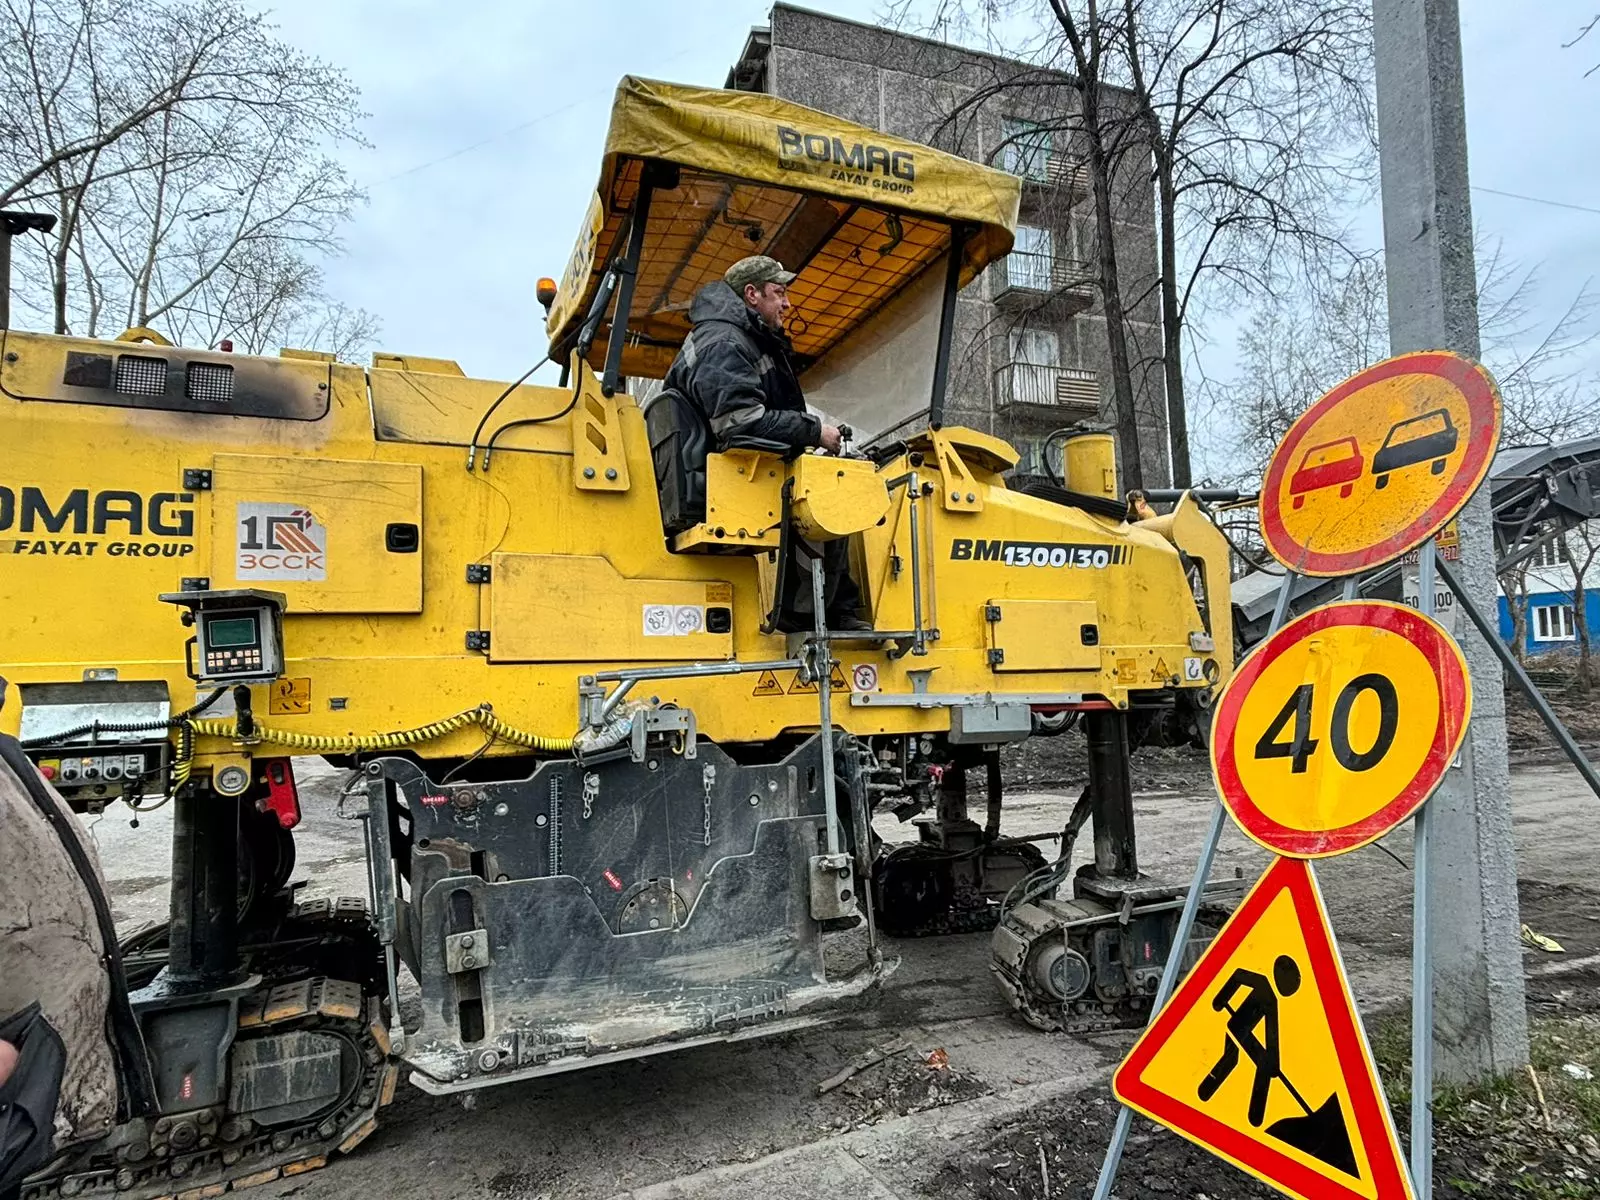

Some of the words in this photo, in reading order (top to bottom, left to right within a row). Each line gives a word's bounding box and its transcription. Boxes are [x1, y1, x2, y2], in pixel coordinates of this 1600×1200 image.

[777, 125, 915, 182] BOMAG
[831, 169, 869, 187] FAYAT
[872, 179, 914, 195] GROUP
[13, 540, 98, 556] FAYAT
[107, 543, 194, 558] GROUP
[1255, 673, 1399, 773] 40
